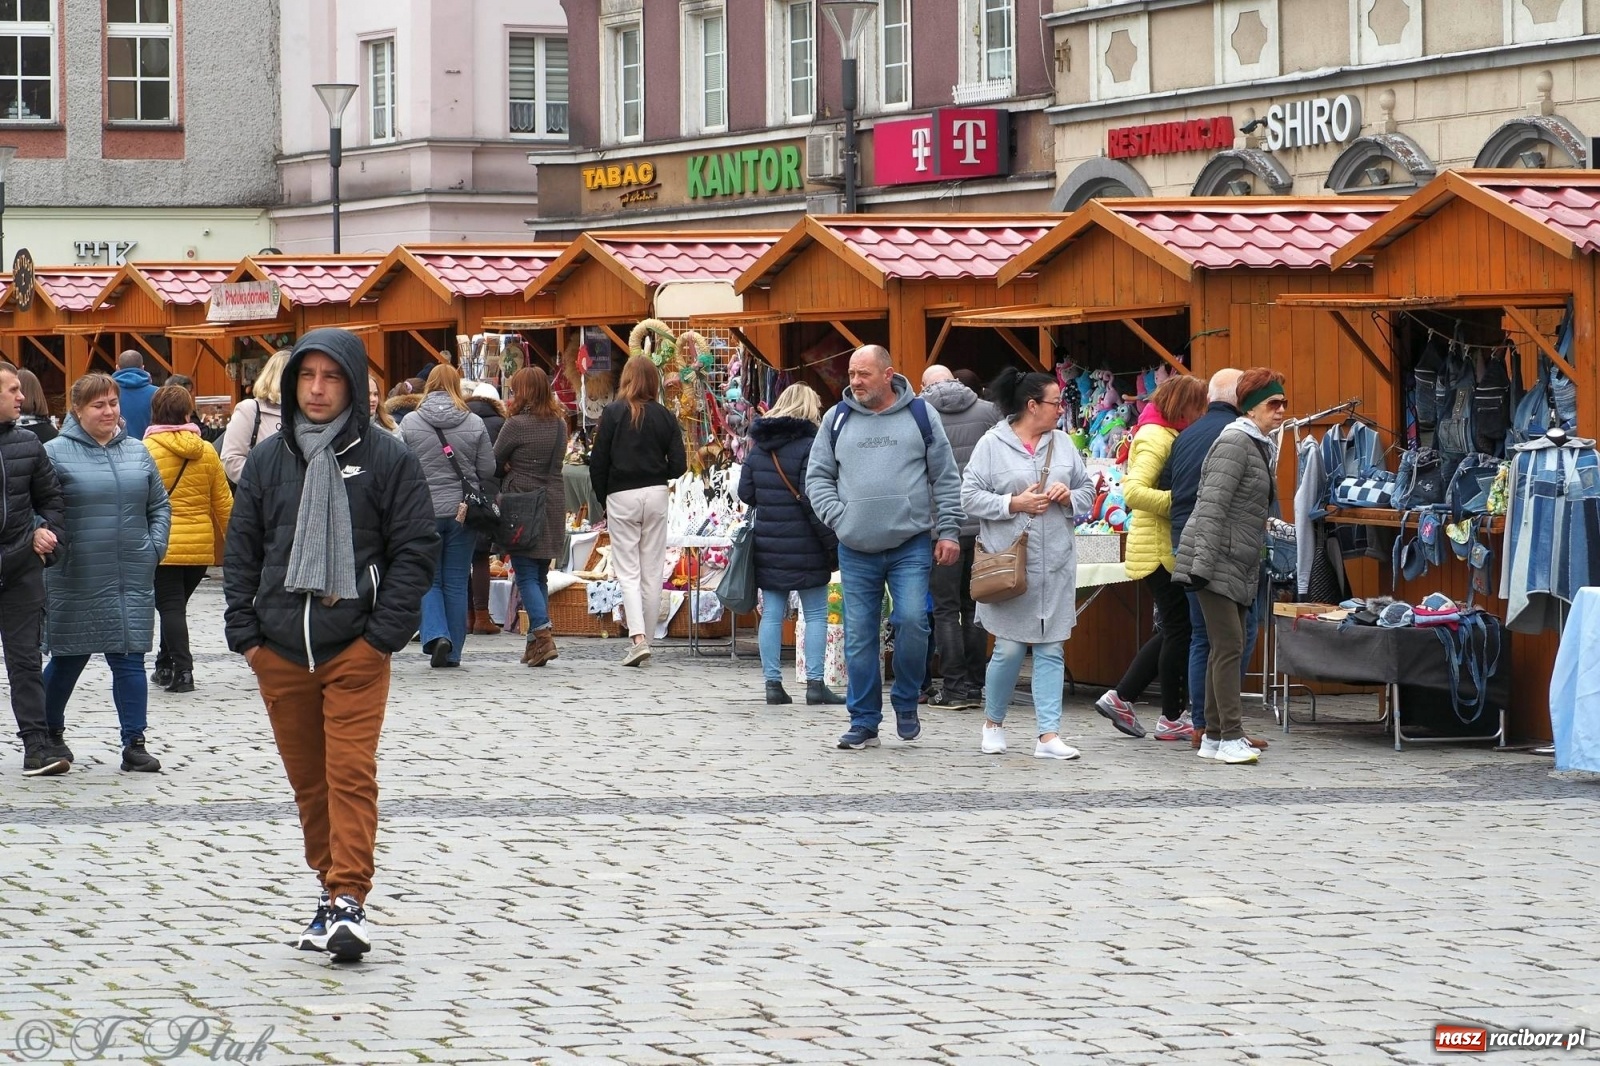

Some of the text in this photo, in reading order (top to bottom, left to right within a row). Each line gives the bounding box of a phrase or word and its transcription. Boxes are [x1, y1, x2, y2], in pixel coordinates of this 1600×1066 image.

[952, 119, 986, 164] T
[1108, 116, 1233, 159] RESTAURACJA
[1267, 94, 1353, 150] SHIRO
[581, 161, 655, 190] TABAC
[686, 145, 801, 198] KANTOR
